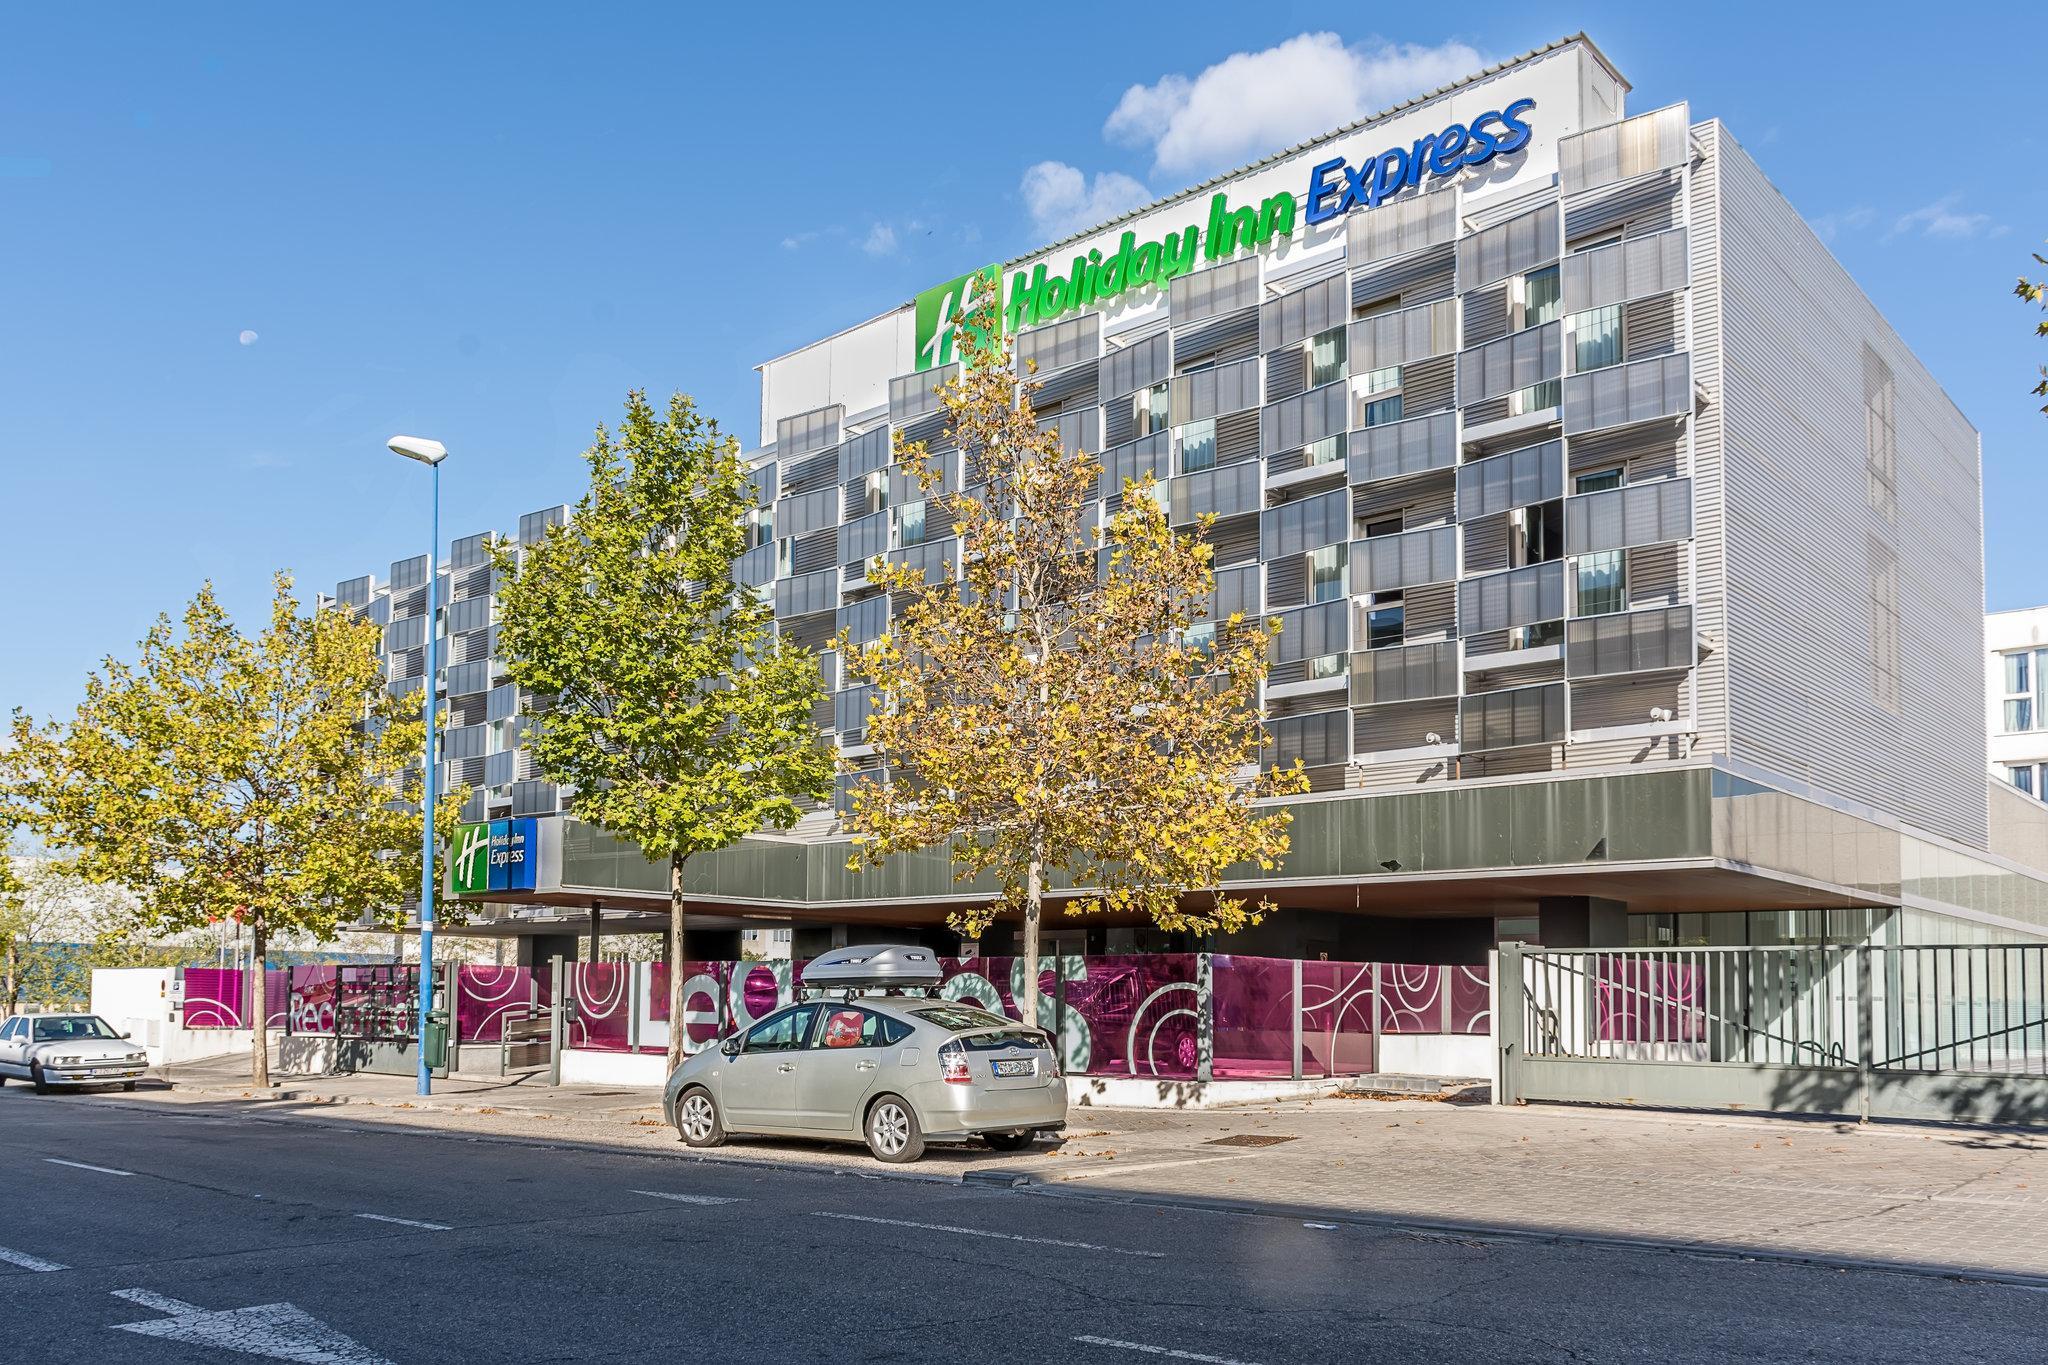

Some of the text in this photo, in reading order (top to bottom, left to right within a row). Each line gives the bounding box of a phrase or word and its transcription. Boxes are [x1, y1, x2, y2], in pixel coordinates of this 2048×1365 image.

[1004, 223, 1199, 332] Holiday
[1205, 191, 1297, 261] Inn
[1305, 97, 1537, 225] Express
[491, 833, 514, 847] Holidy
[490, 849, 525, 867] Express
